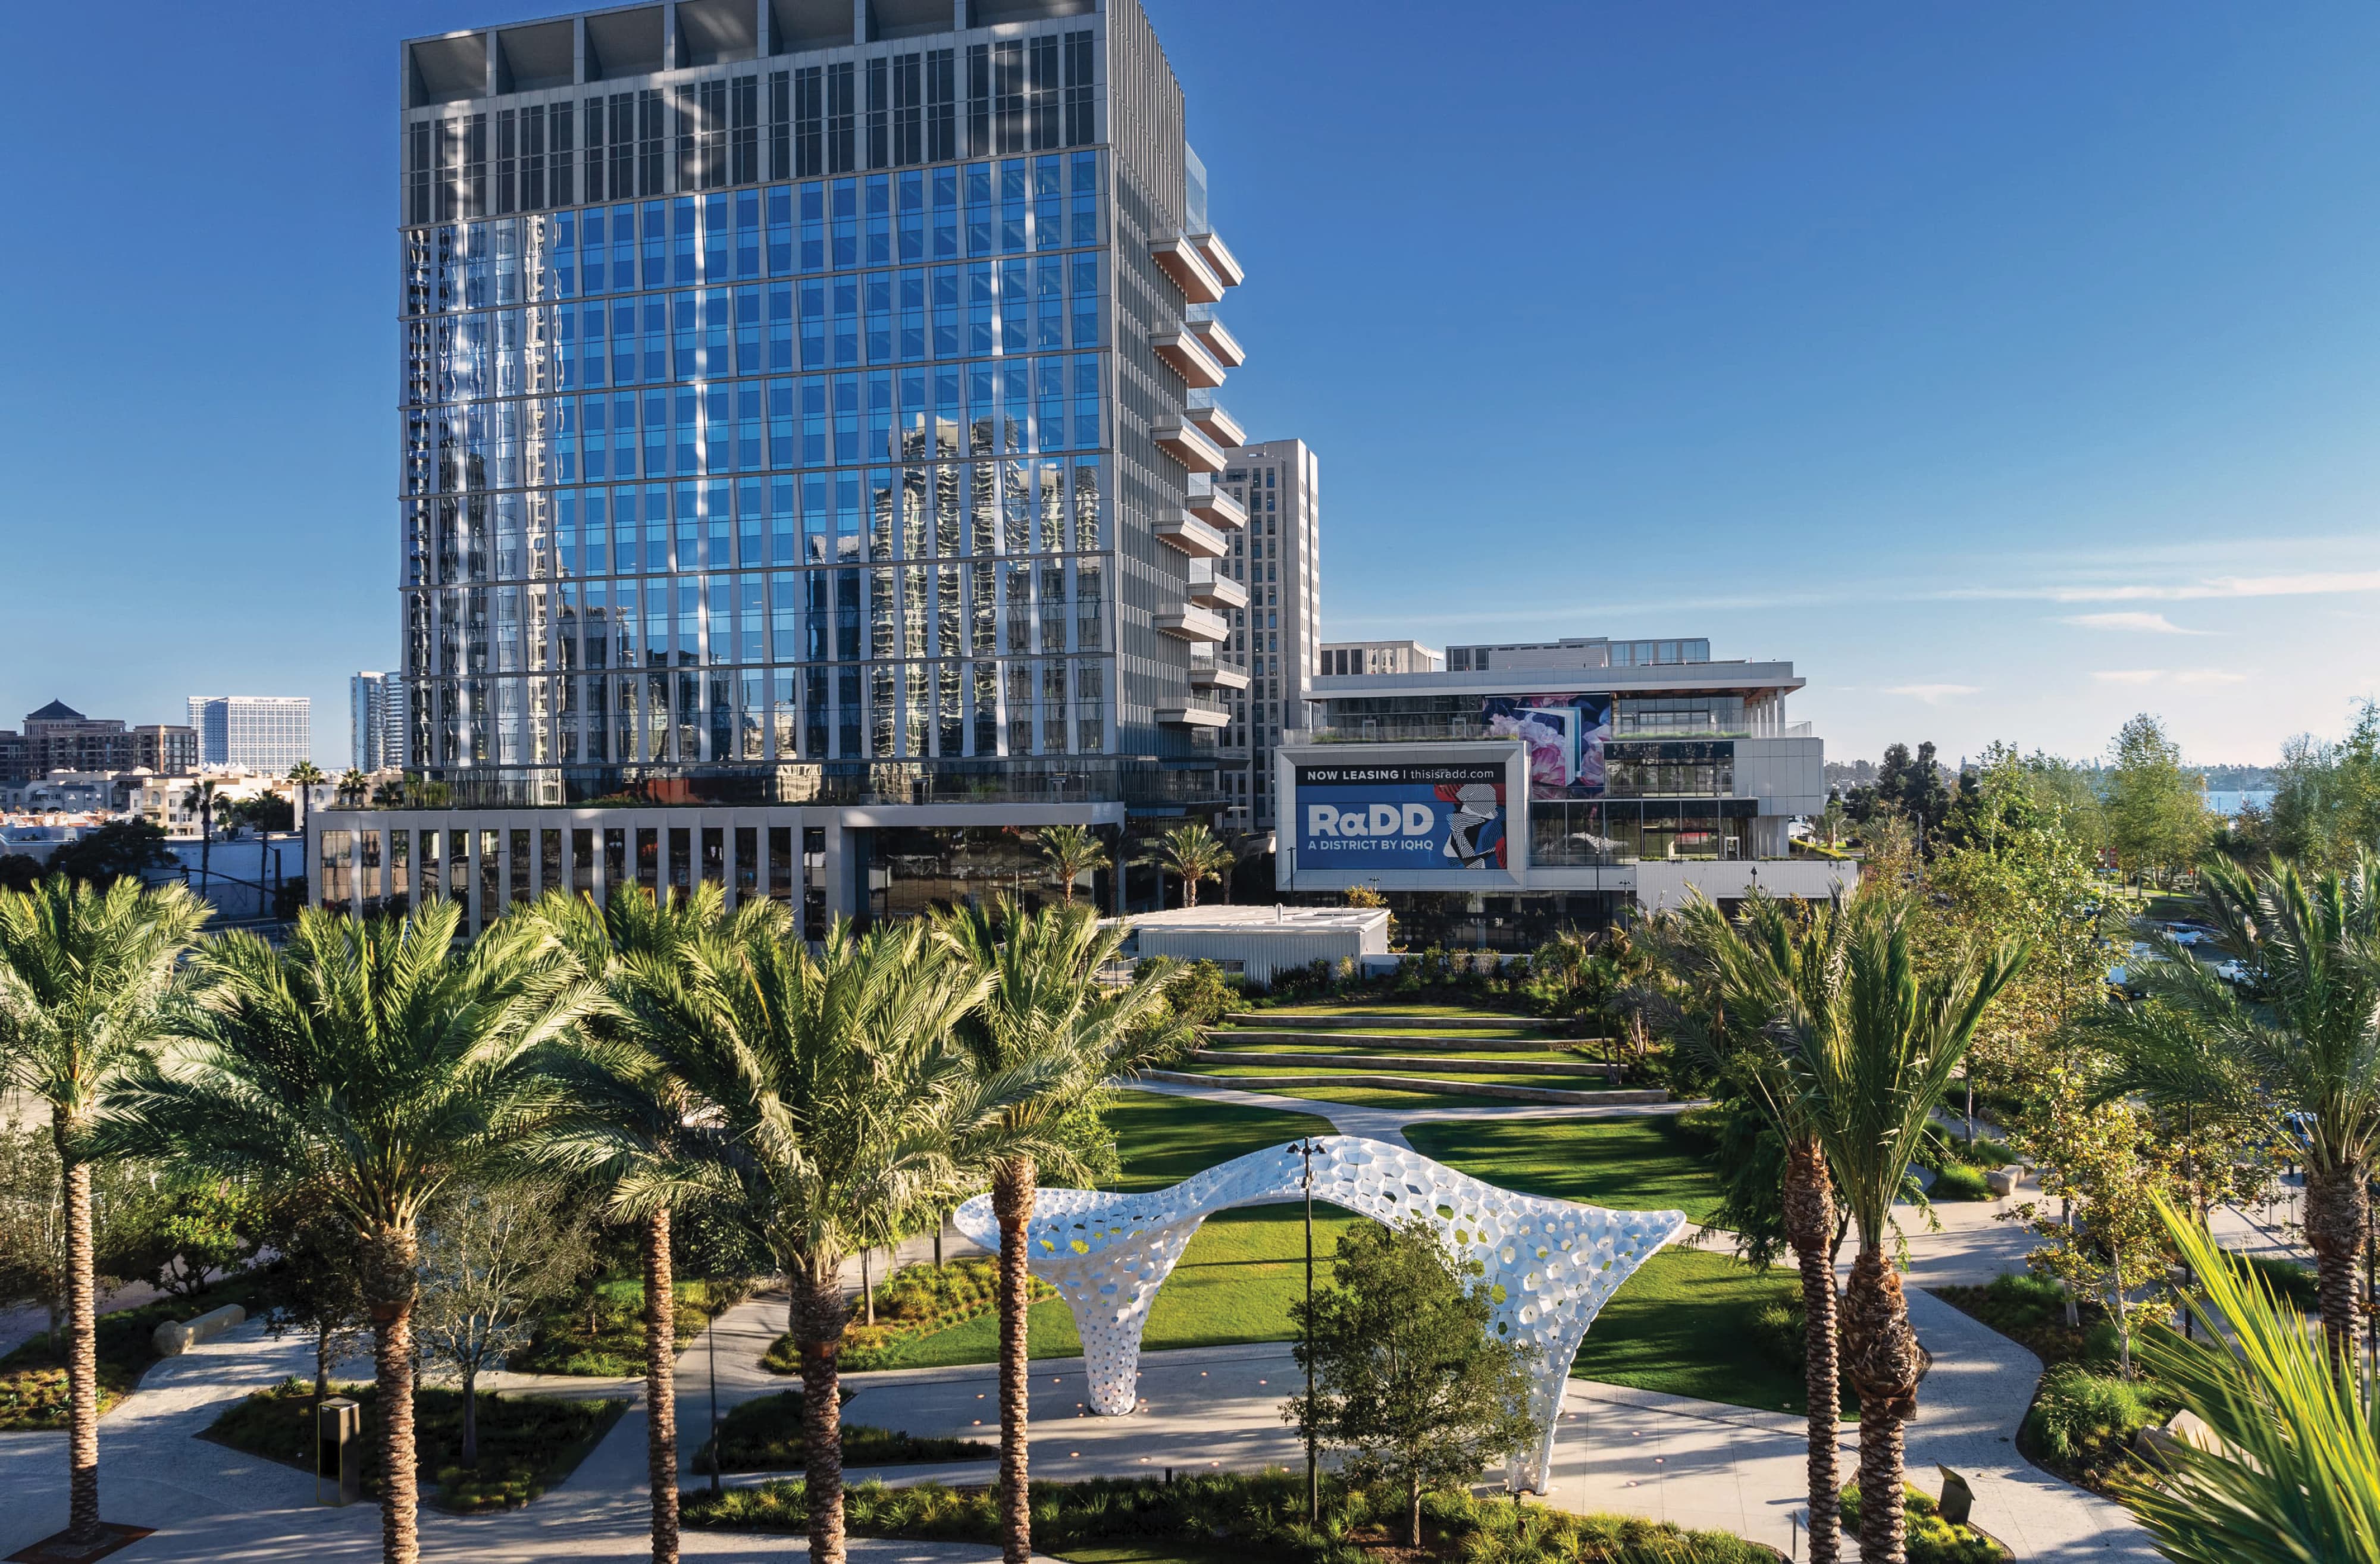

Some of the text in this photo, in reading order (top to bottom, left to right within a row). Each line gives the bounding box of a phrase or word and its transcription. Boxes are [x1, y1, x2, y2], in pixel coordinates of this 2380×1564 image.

[1308, 771, 1338, 780] NOW
[1343, 770, 1399, 779] LEASING
[1411, 769, 1494, 779] thisisradd.com
[1308, 804, 1434, 836] RaDD
[1308, 840, 1433, 851] A DISTRICT BY IQHQ
